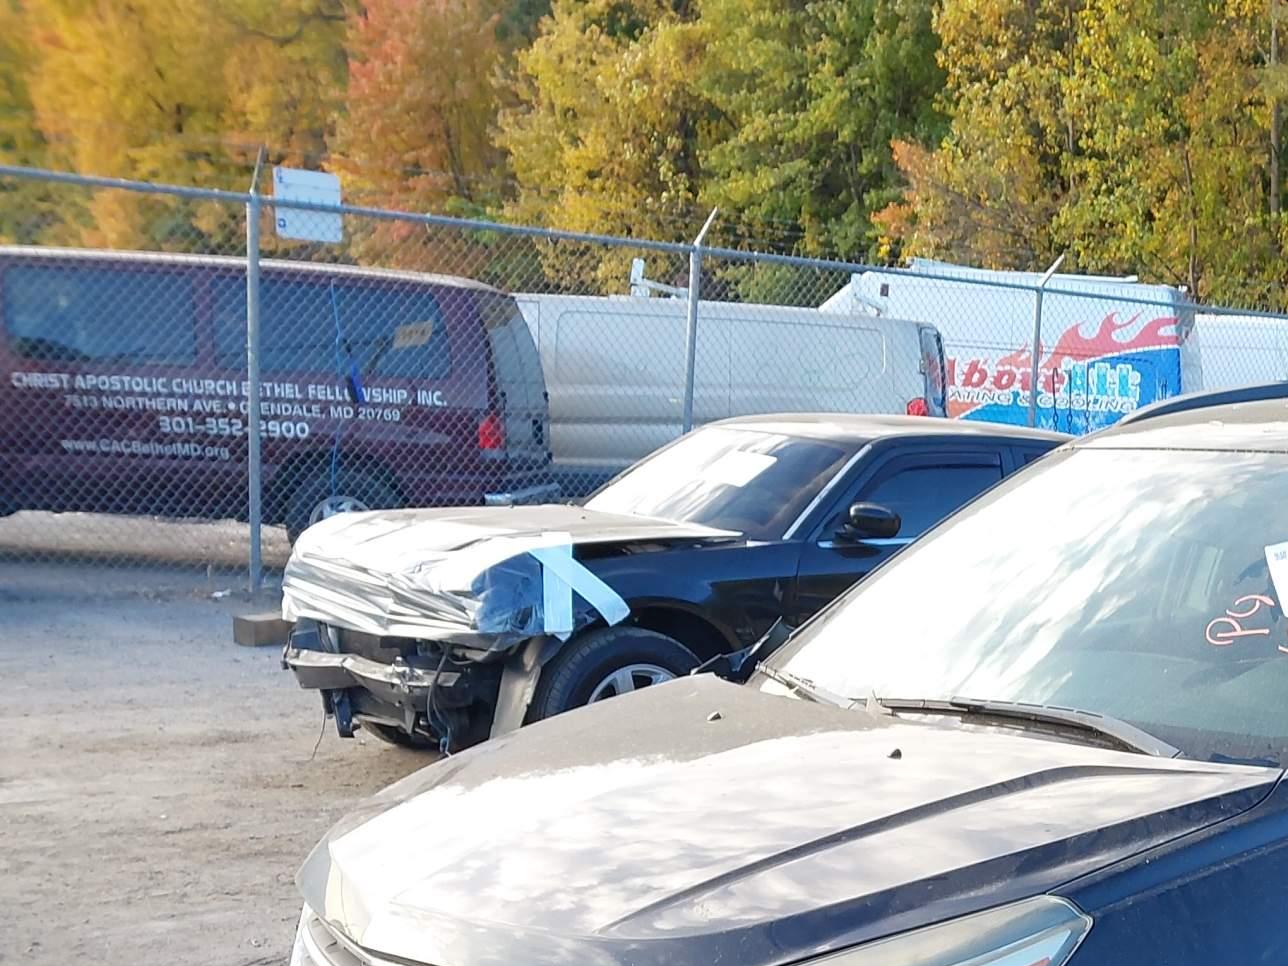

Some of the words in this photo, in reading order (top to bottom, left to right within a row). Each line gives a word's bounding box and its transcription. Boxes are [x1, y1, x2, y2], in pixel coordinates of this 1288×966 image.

[11, 371, 71, 389] CHRIST
[75, 375, 168, 393] APOSTOLIC
[172, 378, 237, 397] CHURCH
[417, 389, 448, 407] INC.
[102, 396, 188, 412] NORTHERN
[330, 405, 354, 419] MD
[358, 408, 400, 423] 20769
